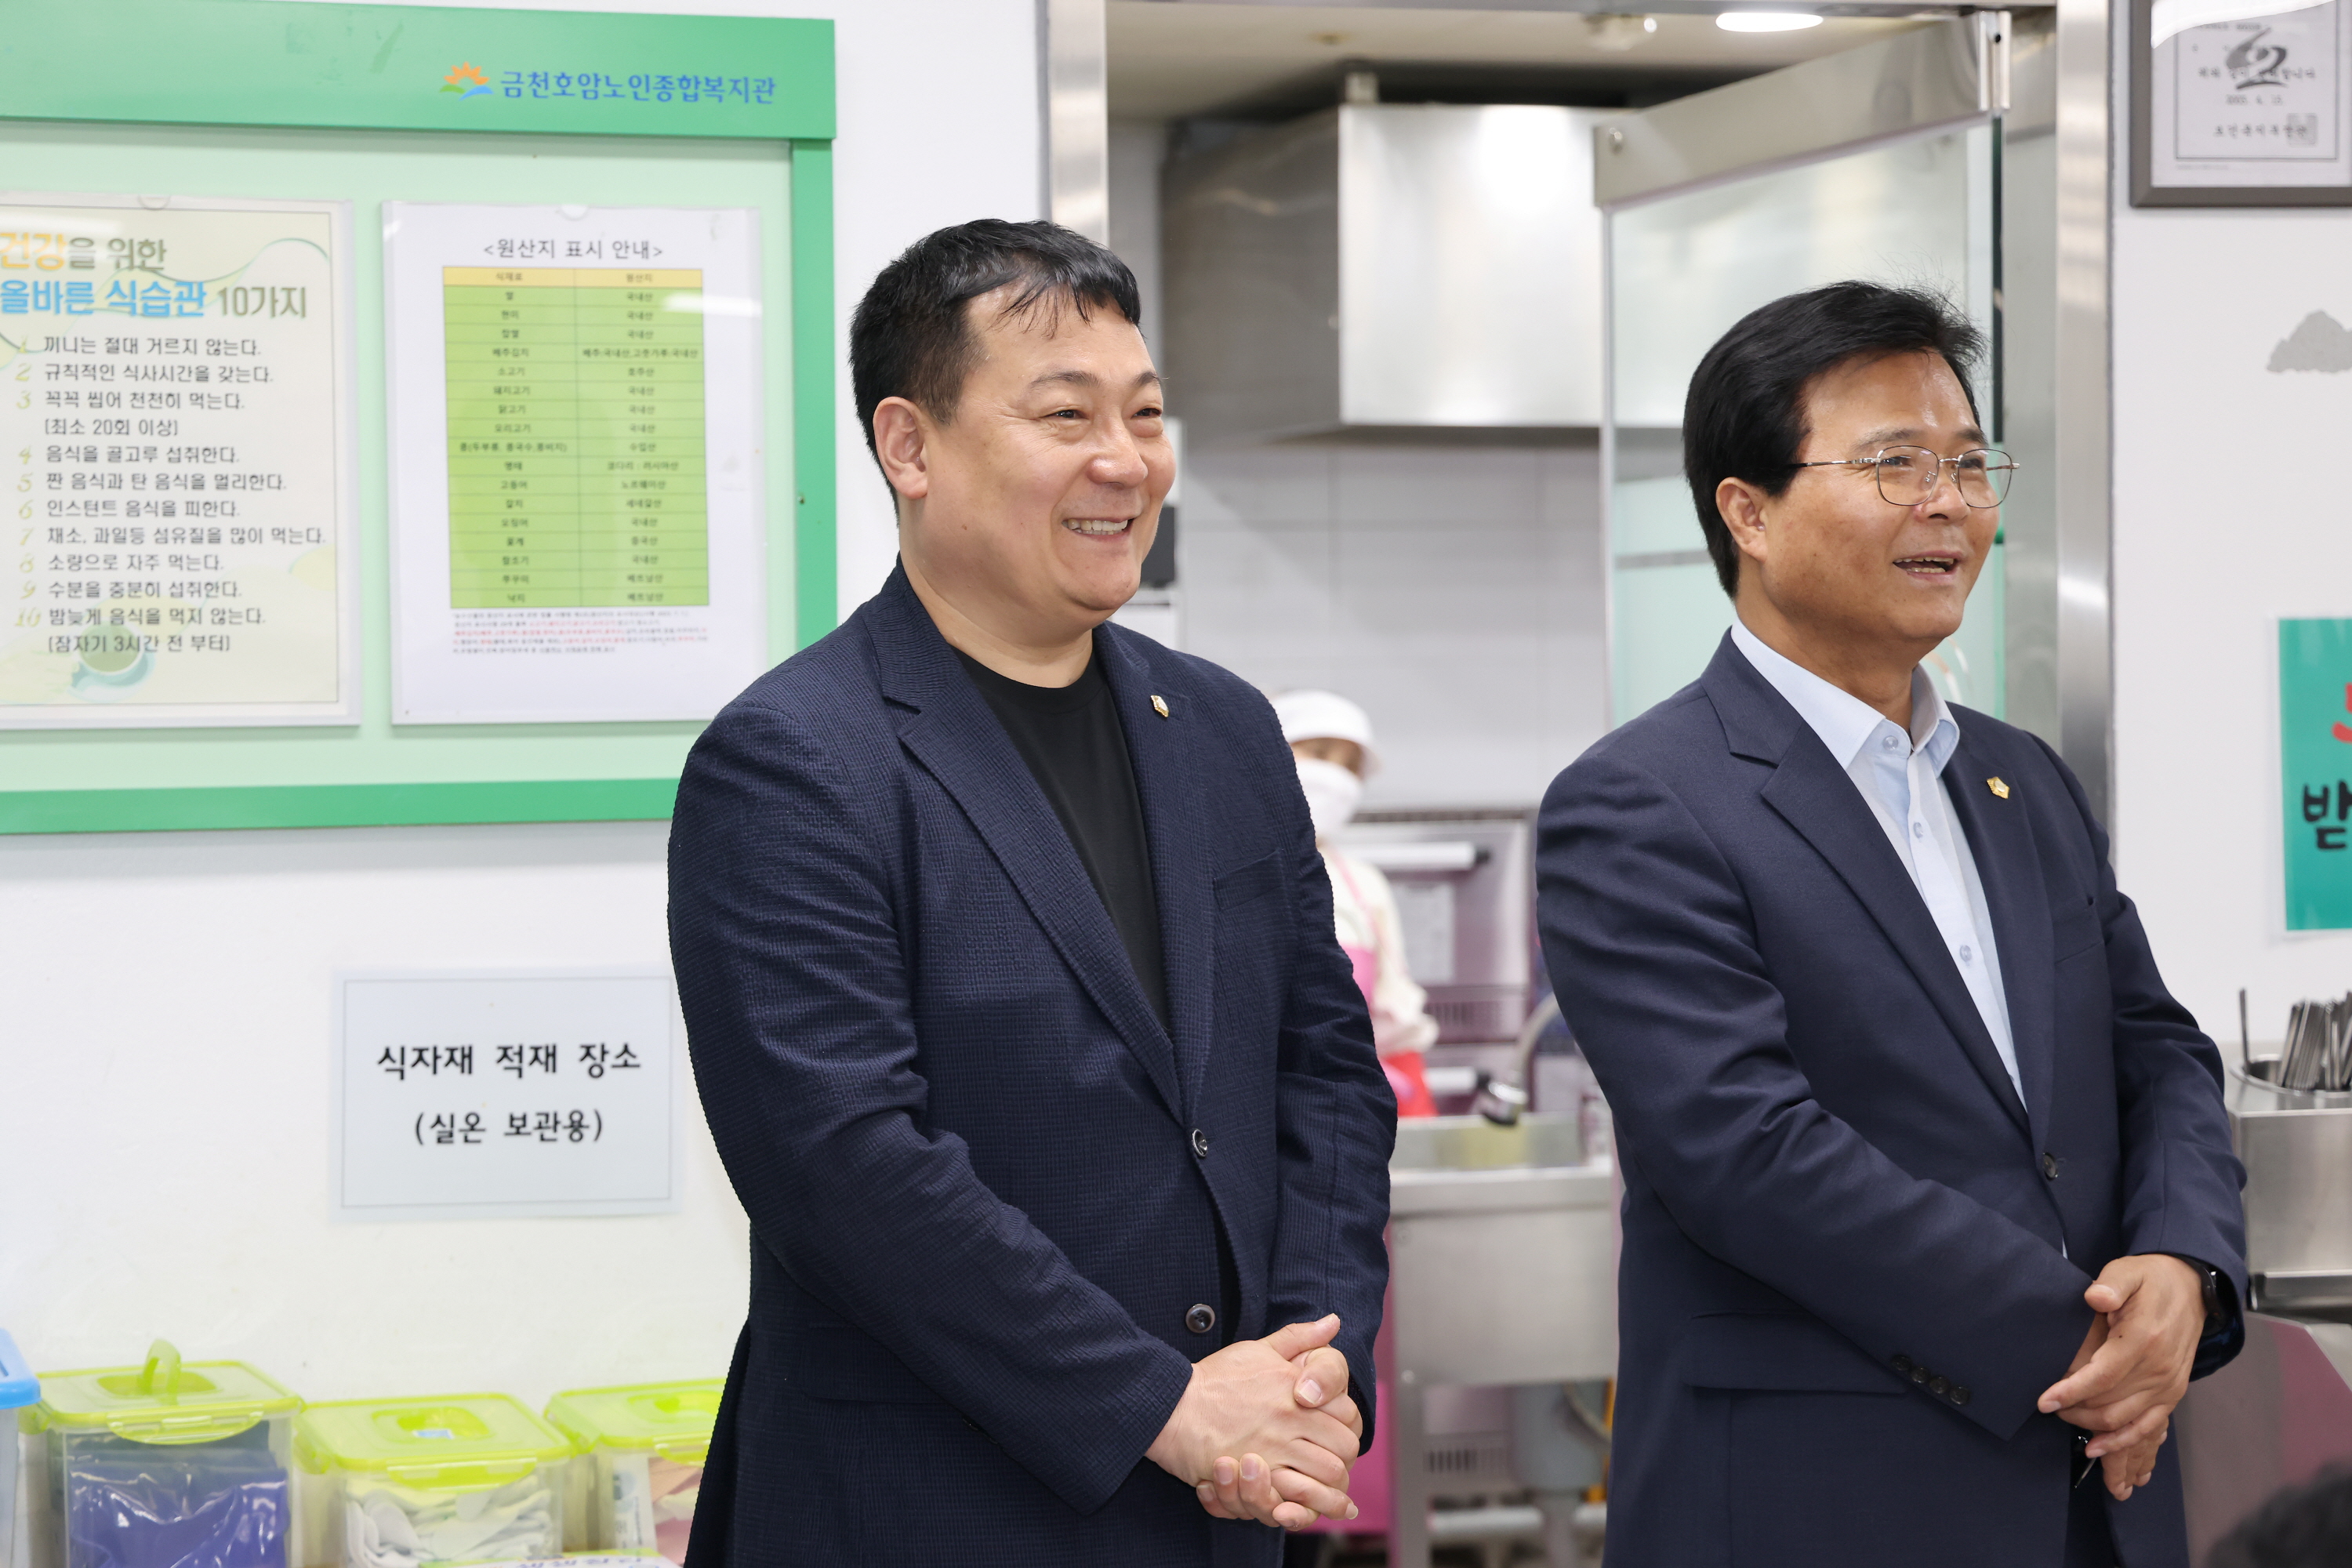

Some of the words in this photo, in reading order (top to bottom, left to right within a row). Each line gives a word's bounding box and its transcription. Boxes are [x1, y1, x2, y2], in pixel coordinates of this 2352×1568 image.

[500, 71, 776, 104] 금천호암노인종합복지관
[0, 232, 96, 270] 건강을
[107, 238, 166, 270] 위한
[565, 239, 603, 259] 표시
[1, 279, 95, 314] 올바른
[105, 280, 207, 318] 식습관
[219, 285, 307, 318] 10가지
[42, 336, 96, 354] 끼니는
[104, 337, 139, 355] 절대
[147, 337, 198, 356] 거르지
[205, 338, 261, 357] 않는다.
[45, 363, 115, 382] 규칙적인
[123, 364, 210, 383] 식사시간을
[218, 365, 274, 383] 갖는다.
[45, 390, 80, 408] 꼭꼭
[87, 390, 122, 409] 씹어
[129, 391, 181, 410] 천천히
[189, 392, 245, 410] 먹는다.
[44, 418, 85, 436] (최소
[93, 419, 130, 436] 20회
[138, 419, 179, 437] 이상)
[46, 445, 98, 463] 음식을
[107, 445, 158, 463] 골고루
[166, 446, 239, 464] 섭취한다.
[46, 472, 64, 491] 짠
[71, 472, 124, 491] 음식과
[131, 473, 147, 491] 탄
[155, 473, 205, 491] 음식을
[213, 474, 286, 492] 멀리한다.
[47, 499, 118, 518] 인스턴트
[125, 499, 176, 518] 음식을
[184, 500, 240, 518] 피한다.
[47, 527, 87, 544] 채소,
[93, 527, 145, 545] 과일등
[153, 527, 222, 545] 섬유질을
[230, 527, 263, 545] 많이
[270, 527, 326, 545] 먹는다.
[49, 554, 118, 572] 소량으로
[127, 554, 159, 572] 자주
[168, 554, 223, 572] 먹는다.
[49, 581, 100, 599] 수분을
[109, 581, 161, 600] 충분히
[169, 581, 241, 599] 섭취한다.
[49, 608, 101, 626] 밤늦게
[110, 608, 161, 626] 음식을
[169, 607, 202, 626] 먹지
[210, 608, 265, 626] 않는다.
[48, 635, 107, 654] (잠자기
[114, 635, 160, 653] 3시간
[167, 634, 183, 653] 전
[191, 634, 230, 652] 부터)
[378, 1044, 474, 1080] 식자재
[496, 1044, 557, 1079] 적재
[579, 1043, 641, 1079] 장소
[415, 1112, 486, 1145] (실온
[504, 1109, 603, 1144] 보관용)
